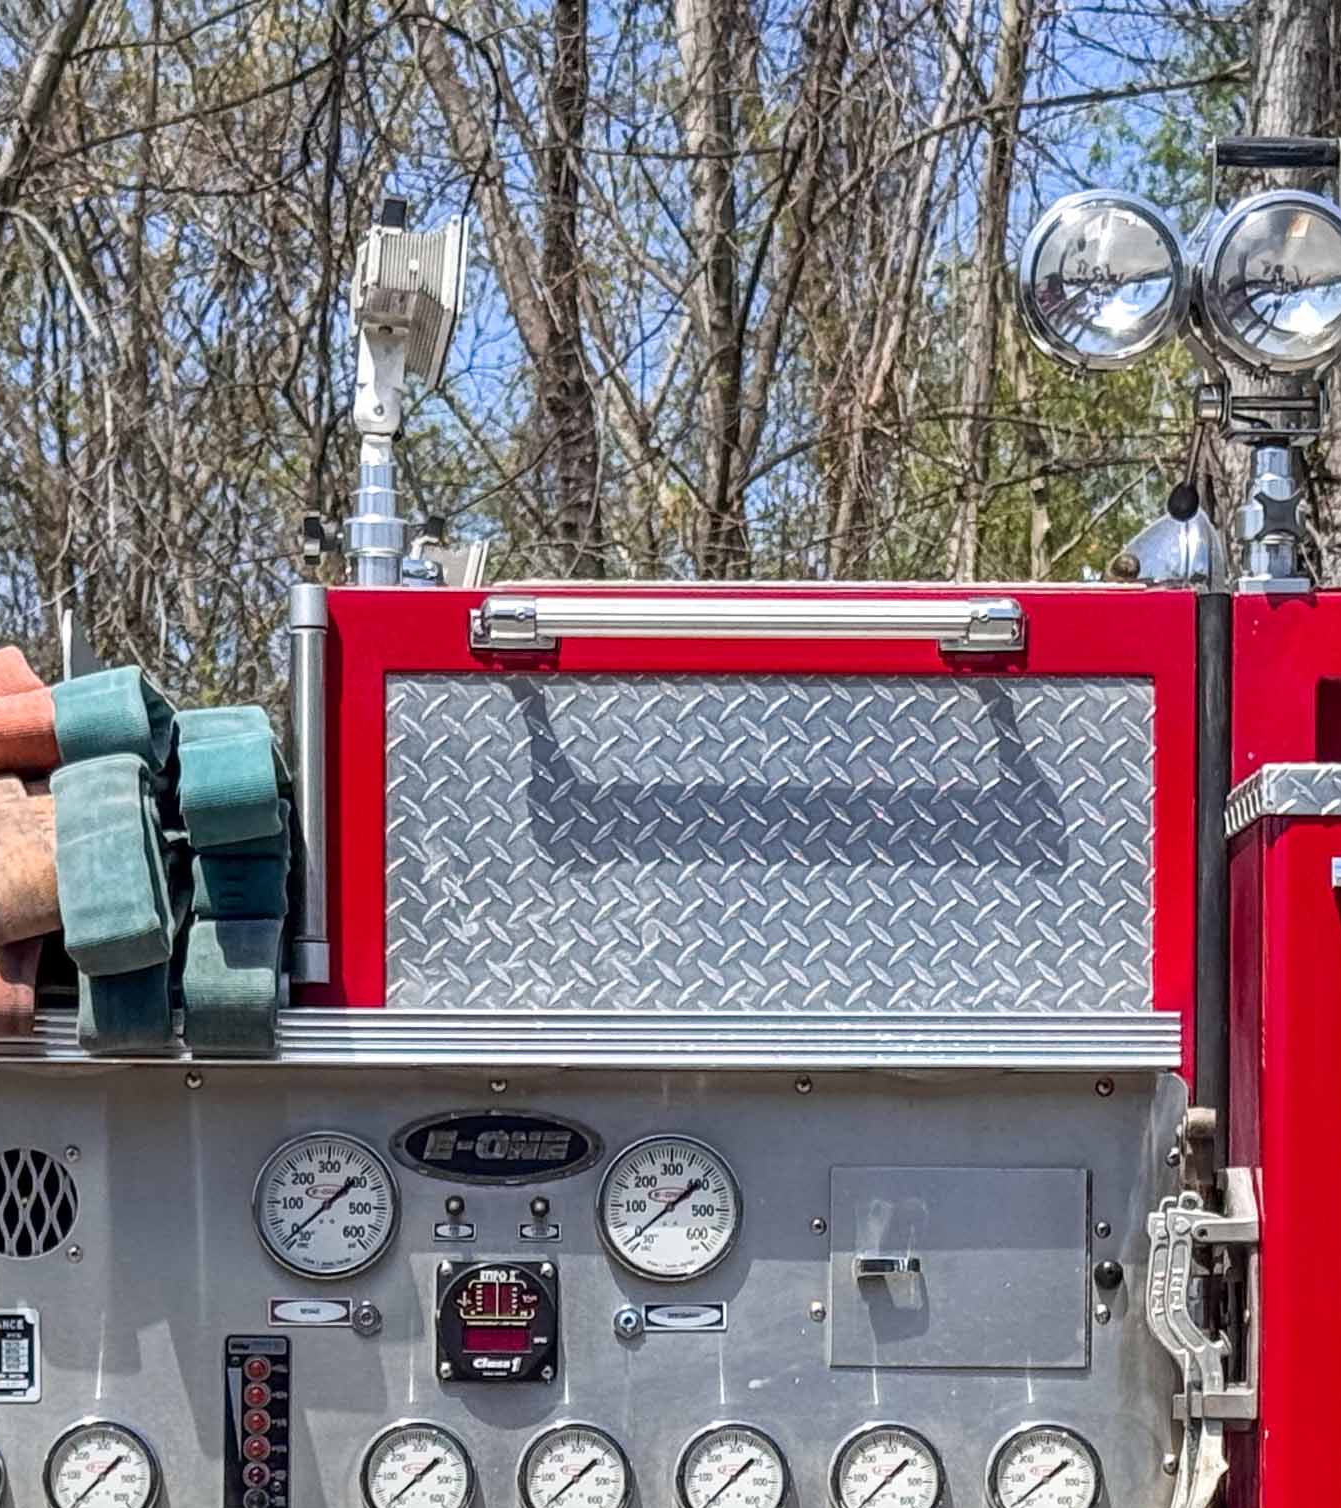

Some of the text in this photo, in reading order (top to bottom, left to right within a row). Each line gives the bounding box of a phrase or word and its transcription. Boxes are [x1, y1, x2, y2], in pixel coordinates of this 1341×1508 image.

[423, 1130, 572, 1160] E-ONE
[318, 1161, 341, 1173] 300
[661, 1164, 683, 1175] 300
[291, 1173, 315, 1185] 200
[635, 1176, 657, 1188] 200
[282, 1198, 303, 1209] 100
[349, 1203, 371, 1214] 500
[625, 1201, 646, 1212] 100
[692, 1205, 714, 1216] 500
[343, 1226, 365, 1238] 600
[686, 1228, 707, 1240] 600
